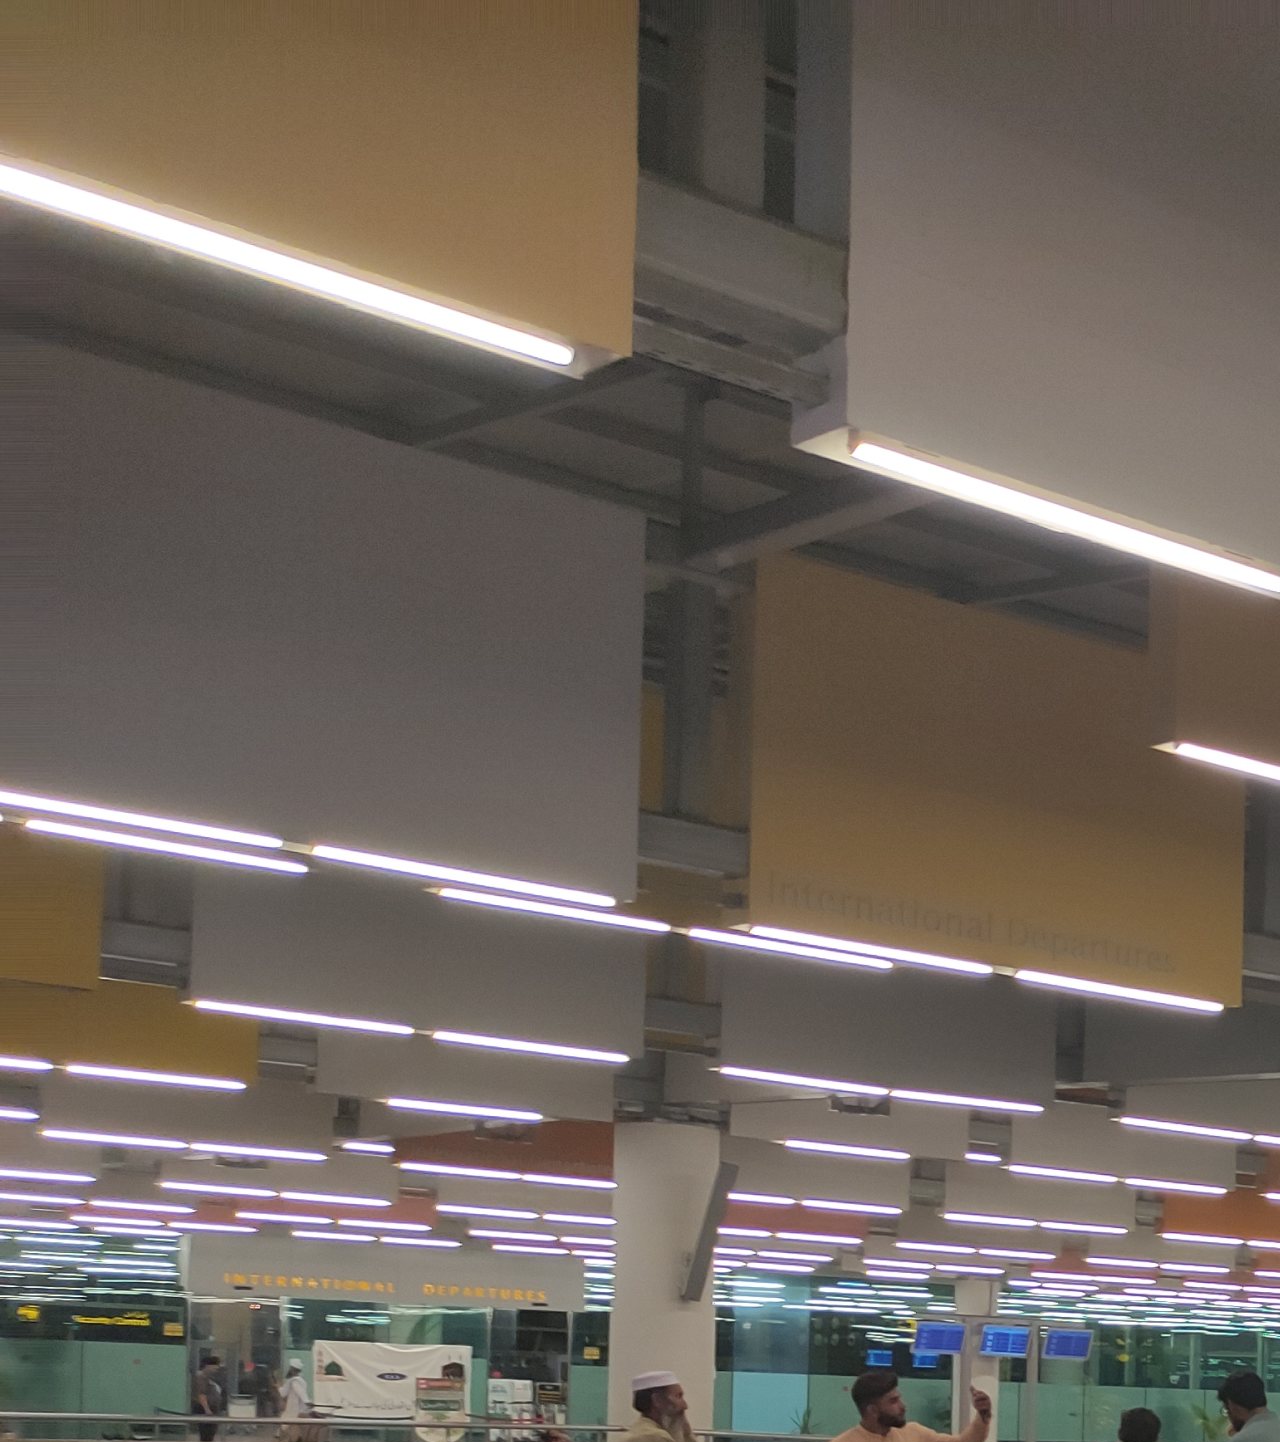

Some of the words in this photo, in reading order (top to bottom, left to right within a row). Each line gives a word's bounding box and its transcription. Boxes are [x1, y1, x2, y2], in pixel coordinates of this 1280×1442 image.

[767, 868, 994, 942] International
[1006, 916, 1177, 977] Departures
[222, 1271, 396, 1294] INTERNATIONAL
[422, 1283, 548, 1302] DEPARTURES
